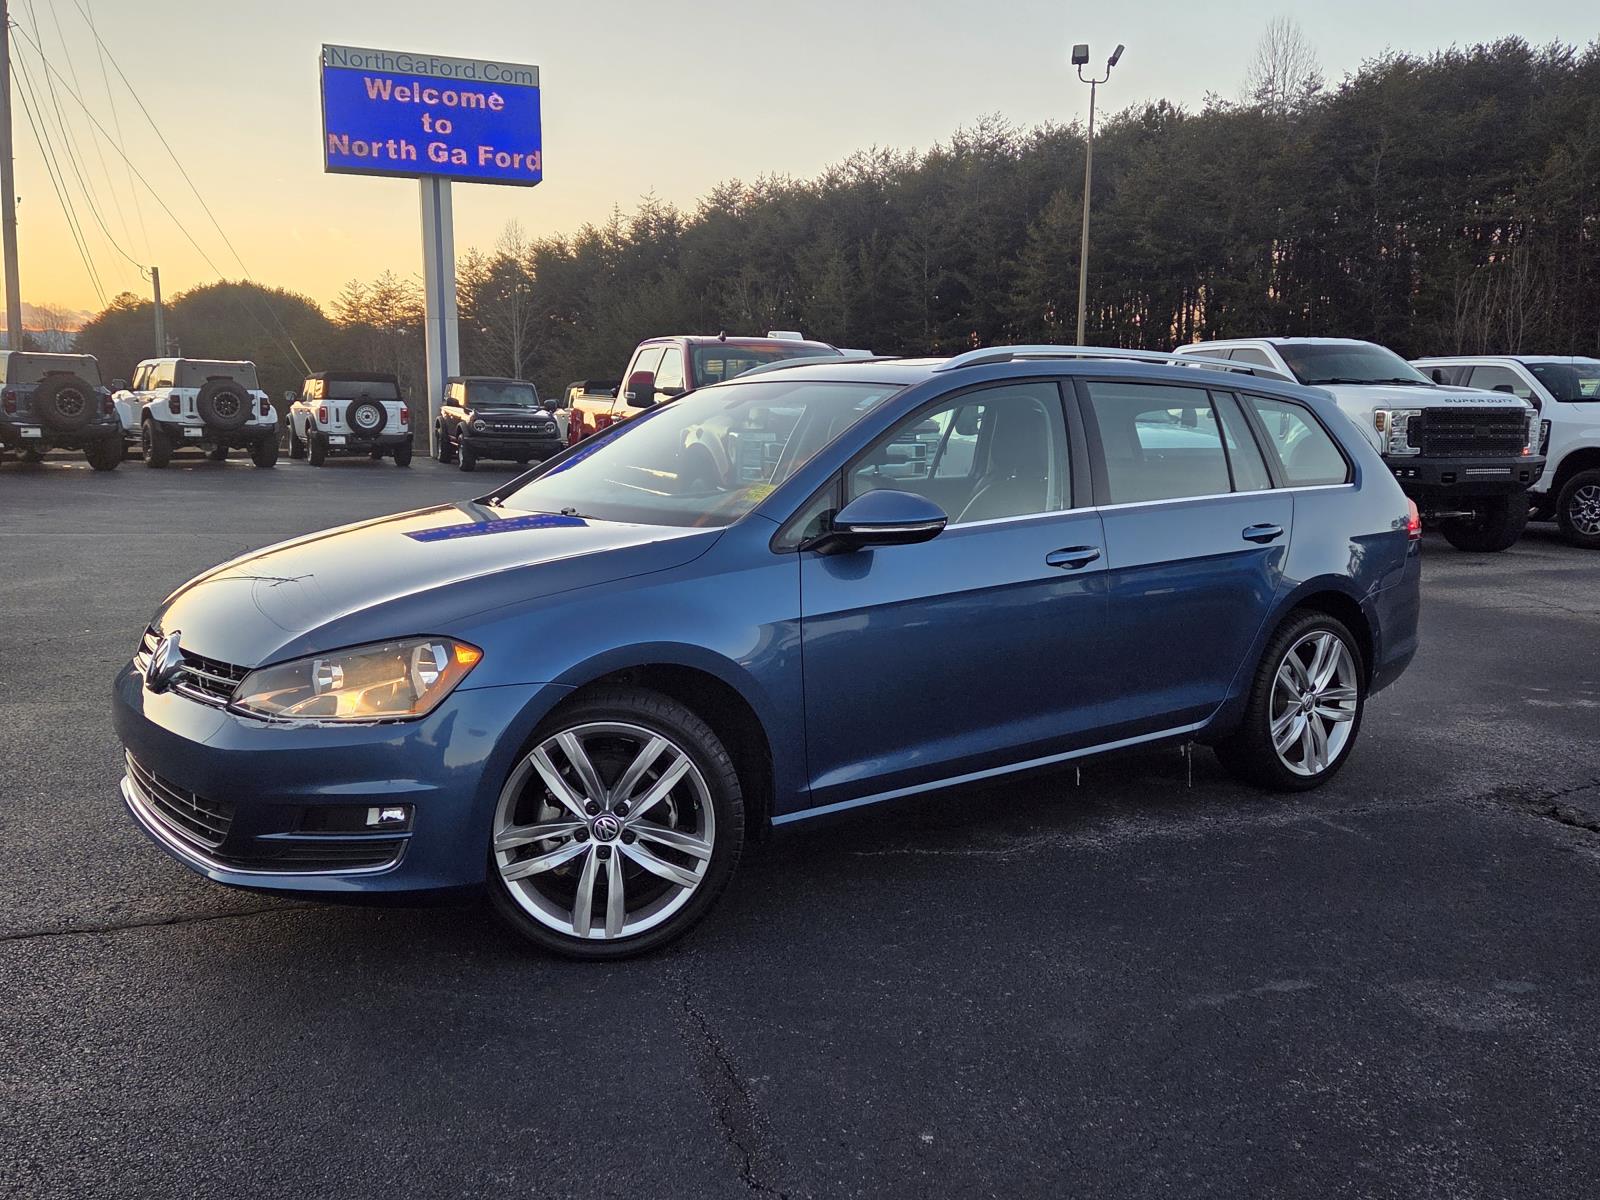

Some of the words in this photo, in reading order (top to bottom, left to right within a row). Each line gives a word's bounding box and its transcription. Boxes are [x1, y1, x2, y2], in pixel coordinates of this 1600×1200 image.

[330, 47, 533, 85] NorthGaFord.Com
[363, 76, 505, 111] Welcome
[421, 112, 452, 134] to
[327, 133, 417, 161] North
[427, 141, 468, 165] Ga
[477, 144, 541, 171] Ford
